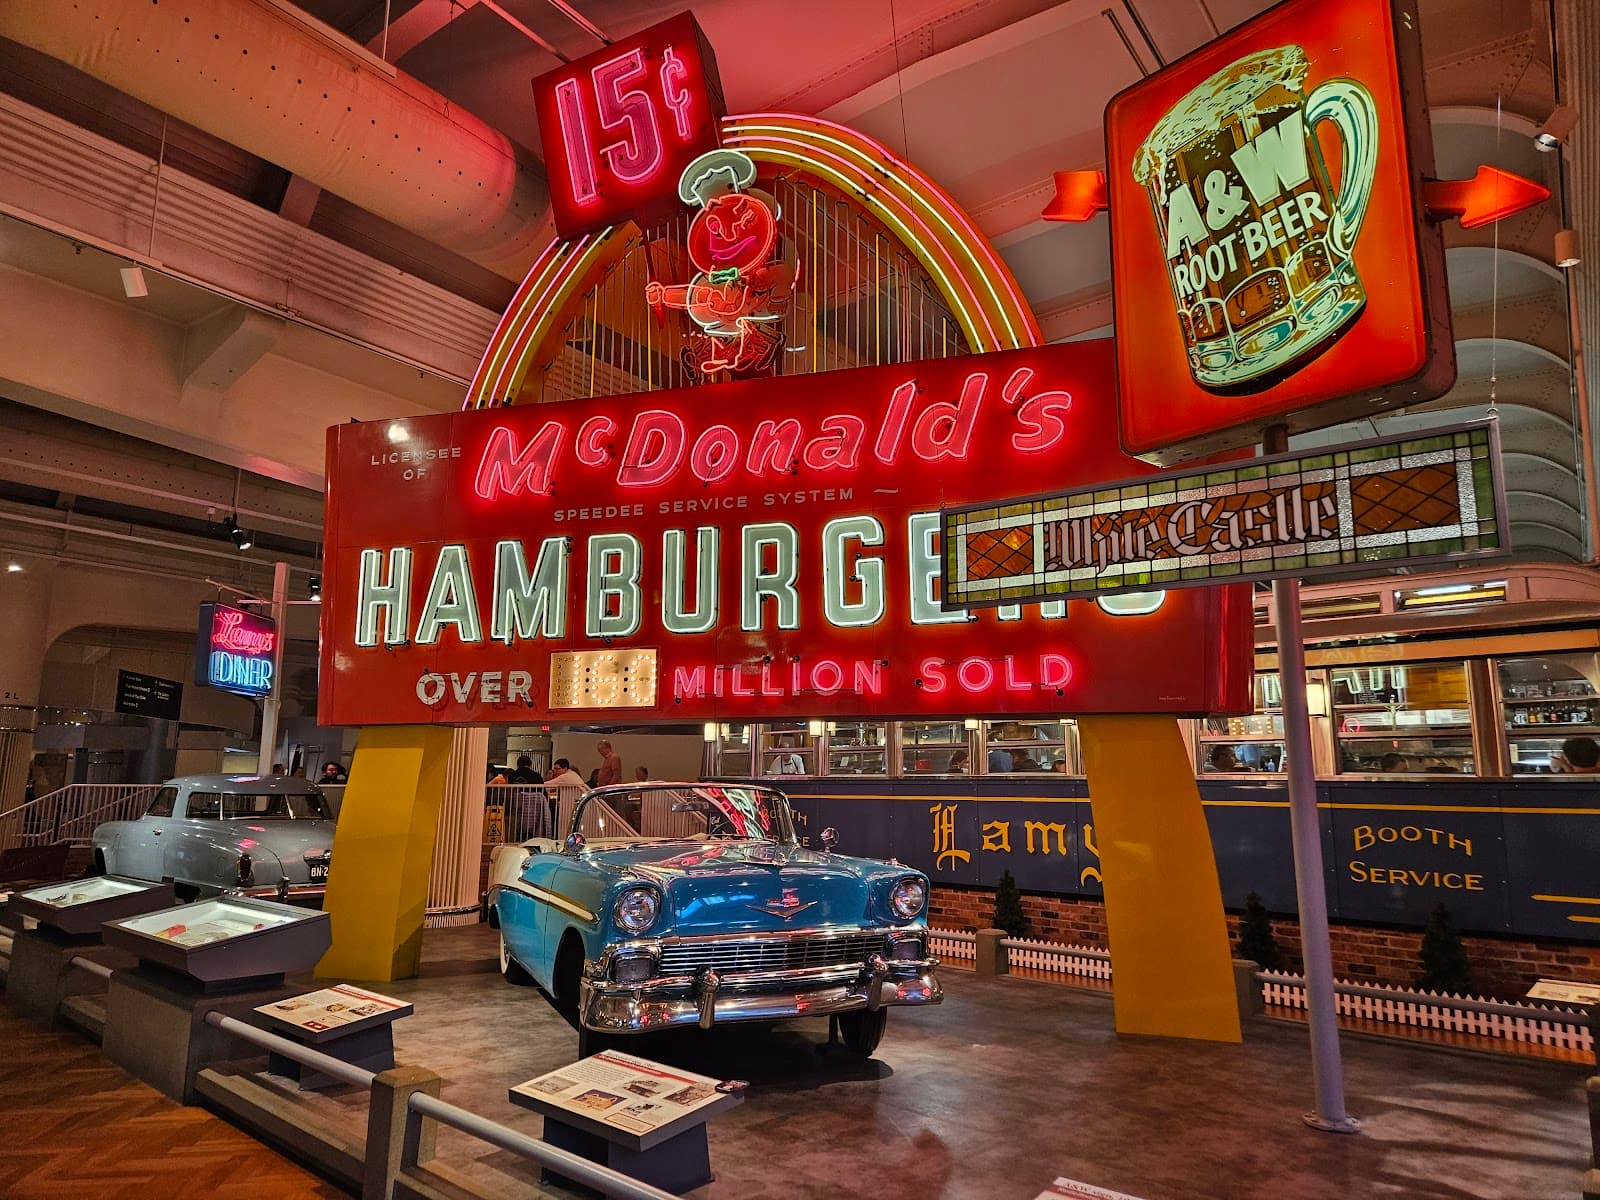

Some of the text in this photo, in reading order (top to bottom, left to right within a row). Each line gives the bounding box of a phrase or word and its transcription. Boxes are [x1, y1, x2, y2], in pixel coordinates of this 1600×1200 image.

[554, 44, 694, 206] 15¢
[1174, 191, 1328, 299] ROOT BEER
[474, 366, 1074, 500] McDonald's
[371, 447, 461, 465] LICENSEE
[403, 469, 426, 480] OF
[554, 487, 854, 522] SPEEDEE SERVICE SYSTEM
[1044, 486, 1340, 578] White Castle
[355, 511, 1167, 647] HAMBURGE
[209, 651, 273, 689] DINER
[416, 670, 533, 706] OVER
[673, 660, 884, 700] MILLION
[919, 653, 1074, 695] SOLD
[1353, 825, 1473, 856] BOOTH
[1348, 861, 1485, 891] SERVICE
